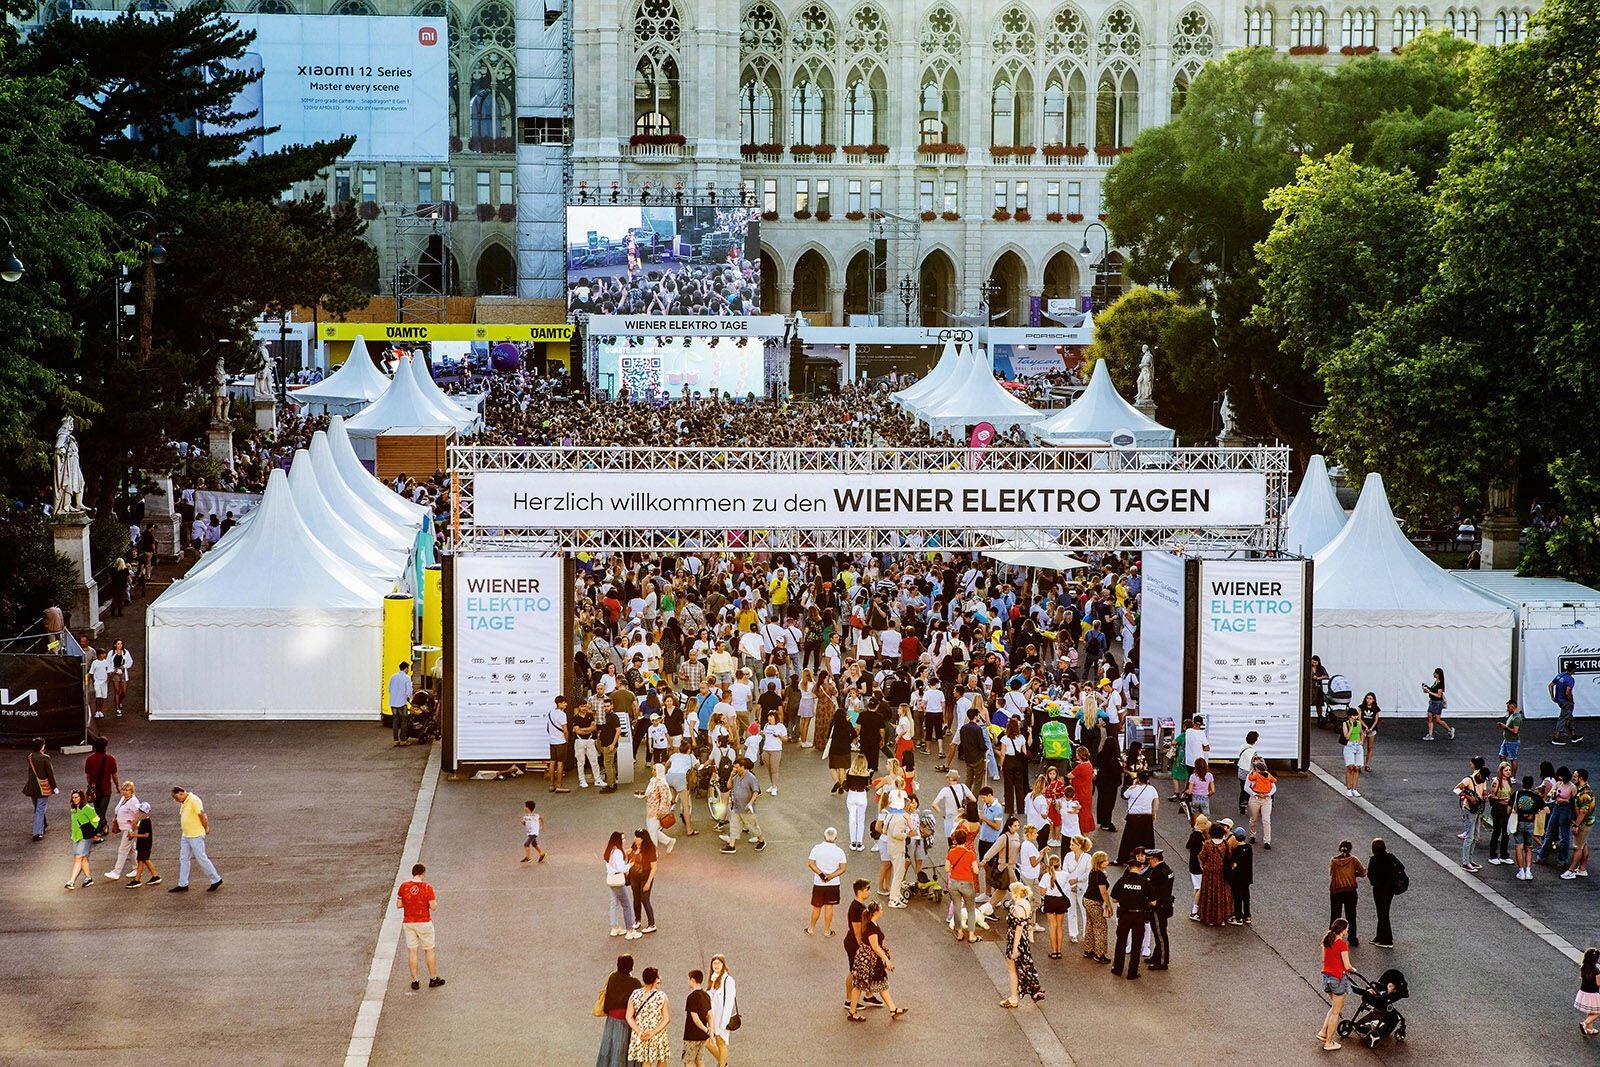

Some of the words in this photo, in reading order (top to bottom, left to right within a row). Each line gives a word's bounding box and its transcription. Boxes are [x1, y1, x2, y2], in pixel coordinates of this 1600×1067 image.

[359, 66, 373, 77] 12
[377, 66, 412, 78] Series
[309, 82, 342, 91] Master
[344, 84, 371, 93] every
[373, 84, 400, 92] scene
[624, 320, 667, 330] WIENER
[669, 320, 718, 330] ELEKTRO
[720, 320, 748, 330] TAGE
[386, 326, 428, 339] ÖAMTC
[1017, 356, 1061, 367] Taycan
[513, 492, 603, 511] Herzlich
[610, 492, 746, 512] willkommen
[752, 498, 778, 512] zu
[783, 493, 827, 512] den
[834, 488, 953, 513] WIENER
[962, 488, 1101, 513] ELEKTRO
[1109, 488, 1210, 513] TAGEN
[467, 578, 540, 593] WIENER
[1211, 581, 1282, 596] WIENER
[467, 597, 551, 612] ELEKTRO
[1211, 600, 1293, 614] ELEKTRO
[467, 615, 515, 630] TAGE
[1210, 618, 1257, 632] TAGE
[15, 710, 39, 718] inspires
